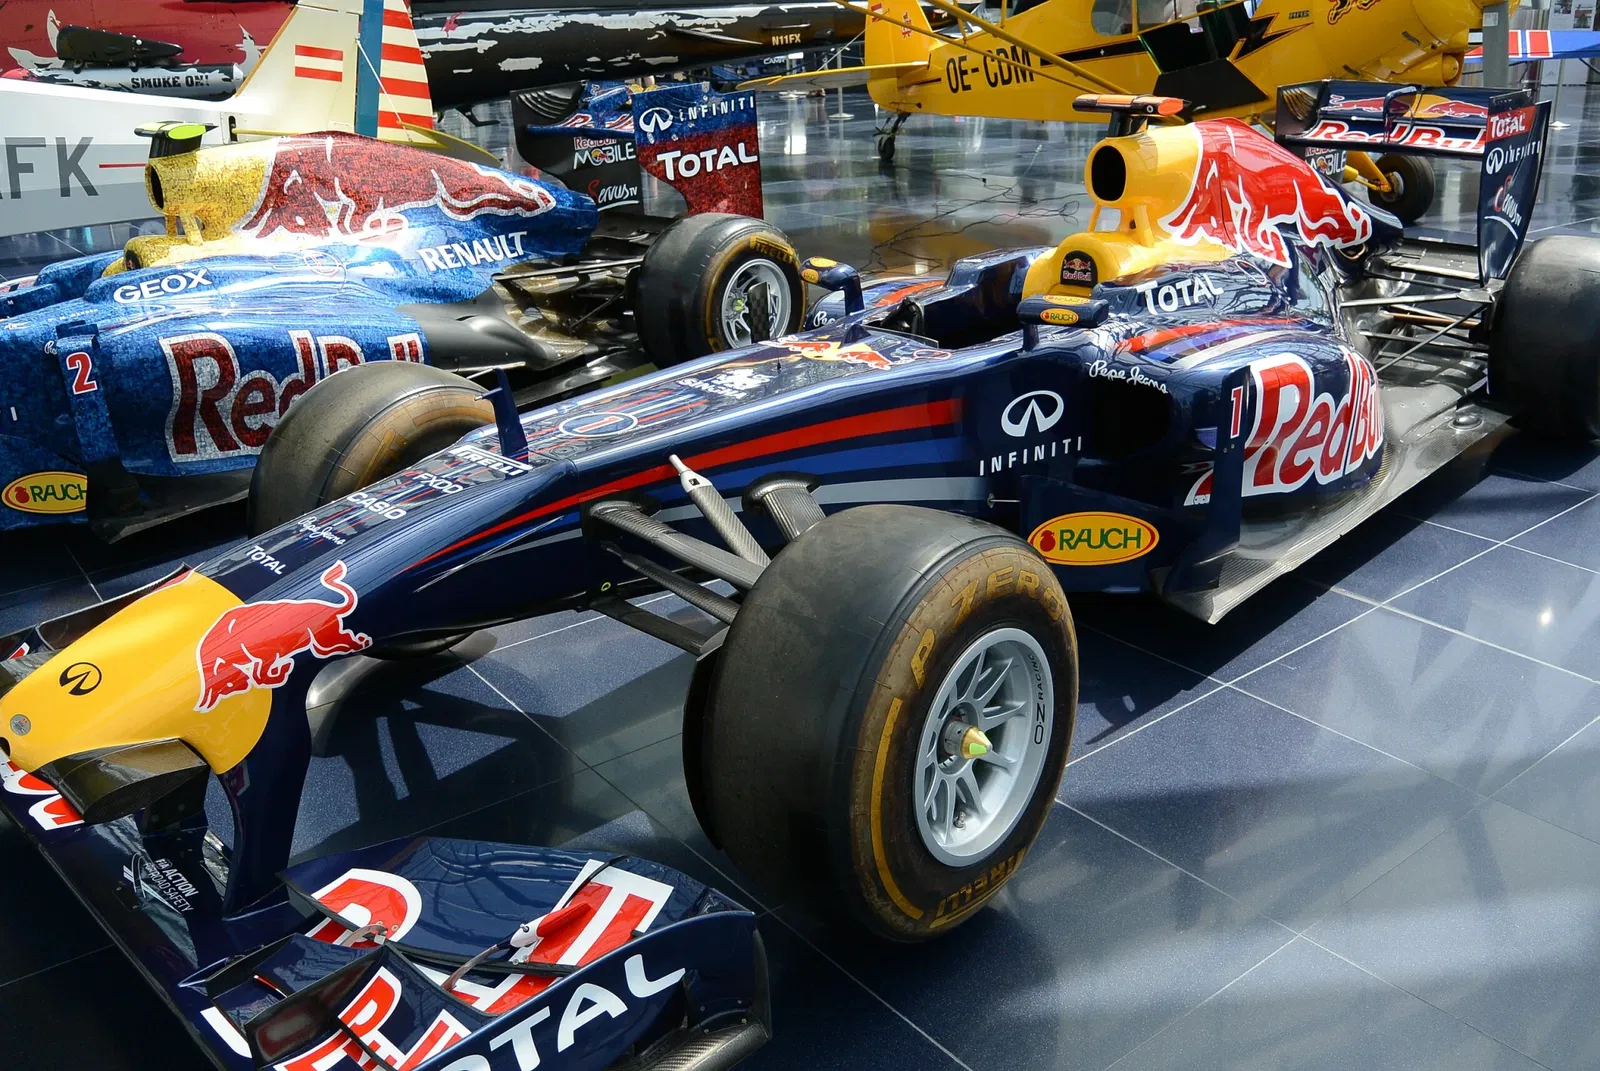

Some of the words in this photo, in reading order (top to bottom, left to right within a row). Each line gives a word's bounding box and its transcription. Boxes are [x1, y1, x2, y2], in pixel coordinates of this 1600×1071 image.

[771, 33, 801, 46] N11FX
[131, 76, 181, 89] SMOKE
[946, 45, 1034, 94] OE-CDM
[680, 96, 754, 122] INFINITI
[1490, 112, 1526, 139] TOTAL
[0, 137, 99, 200] FK
[573, 142, 637, 170] MOBILE
[657, 143, 759, 181] TOTAL
[416, 231, 528, 272] RENAULT
[113, 268, 213, 304] GEOX
[1063, 270, 1077, 280] Red
[1136, 274, 1224, 316] TOTAL
[1050, 311, 1074, 322] RAUCH
[66, 352, 98, 395] 2
[1086, 360, 1126, 381] Pepe
[1126, 366, 1168, 395] Jeans
[1230, 385, 1244, 439] 1
[1241, 345, 1359, 498] Red
[448, 444, 534, 476] PIRELLI
[979, 436, 1082, 477] INFINITI
[412, 472, 464, 494] FXDD
[346, 492, 407, 520] CASIO
[1059, 527, 1142, 551] RAUCH
[246, 544, 286, 575] TOTAL
[910, 628, 936, 690] P
[950, 565, 1064, 629] ZERO
[1028, 653, 1044, 700] RACING
[162, 868, 199, 898] ACTION
[163, 887, 194, 912] SAFETY
[438, 953, 686, 1071] TAL
